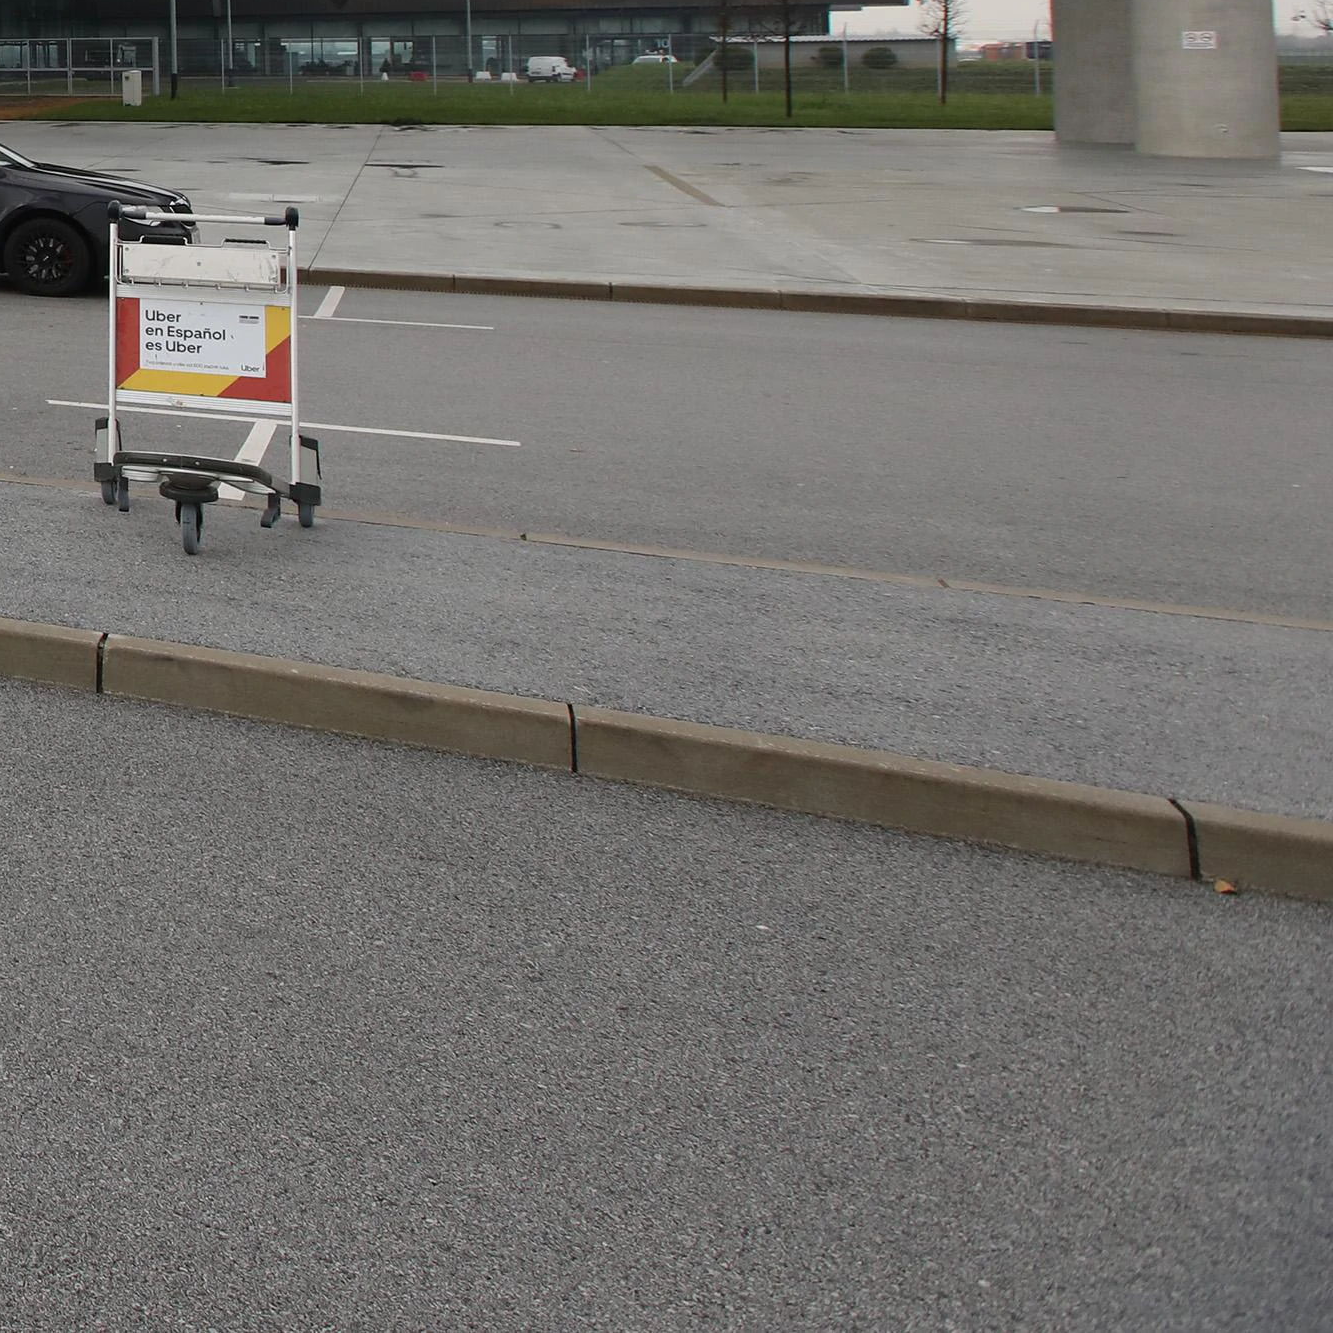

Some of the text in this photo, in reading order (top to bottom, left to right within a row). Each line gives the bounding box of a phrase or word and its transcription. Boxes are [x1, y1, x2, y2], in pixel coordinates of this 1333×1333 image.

[145, 309, 182, 323] Uber
[145, 325, 226, 341] en Español
[145, 340, 203, 354] es Uber
[240, 364, 261, 373] Uber
